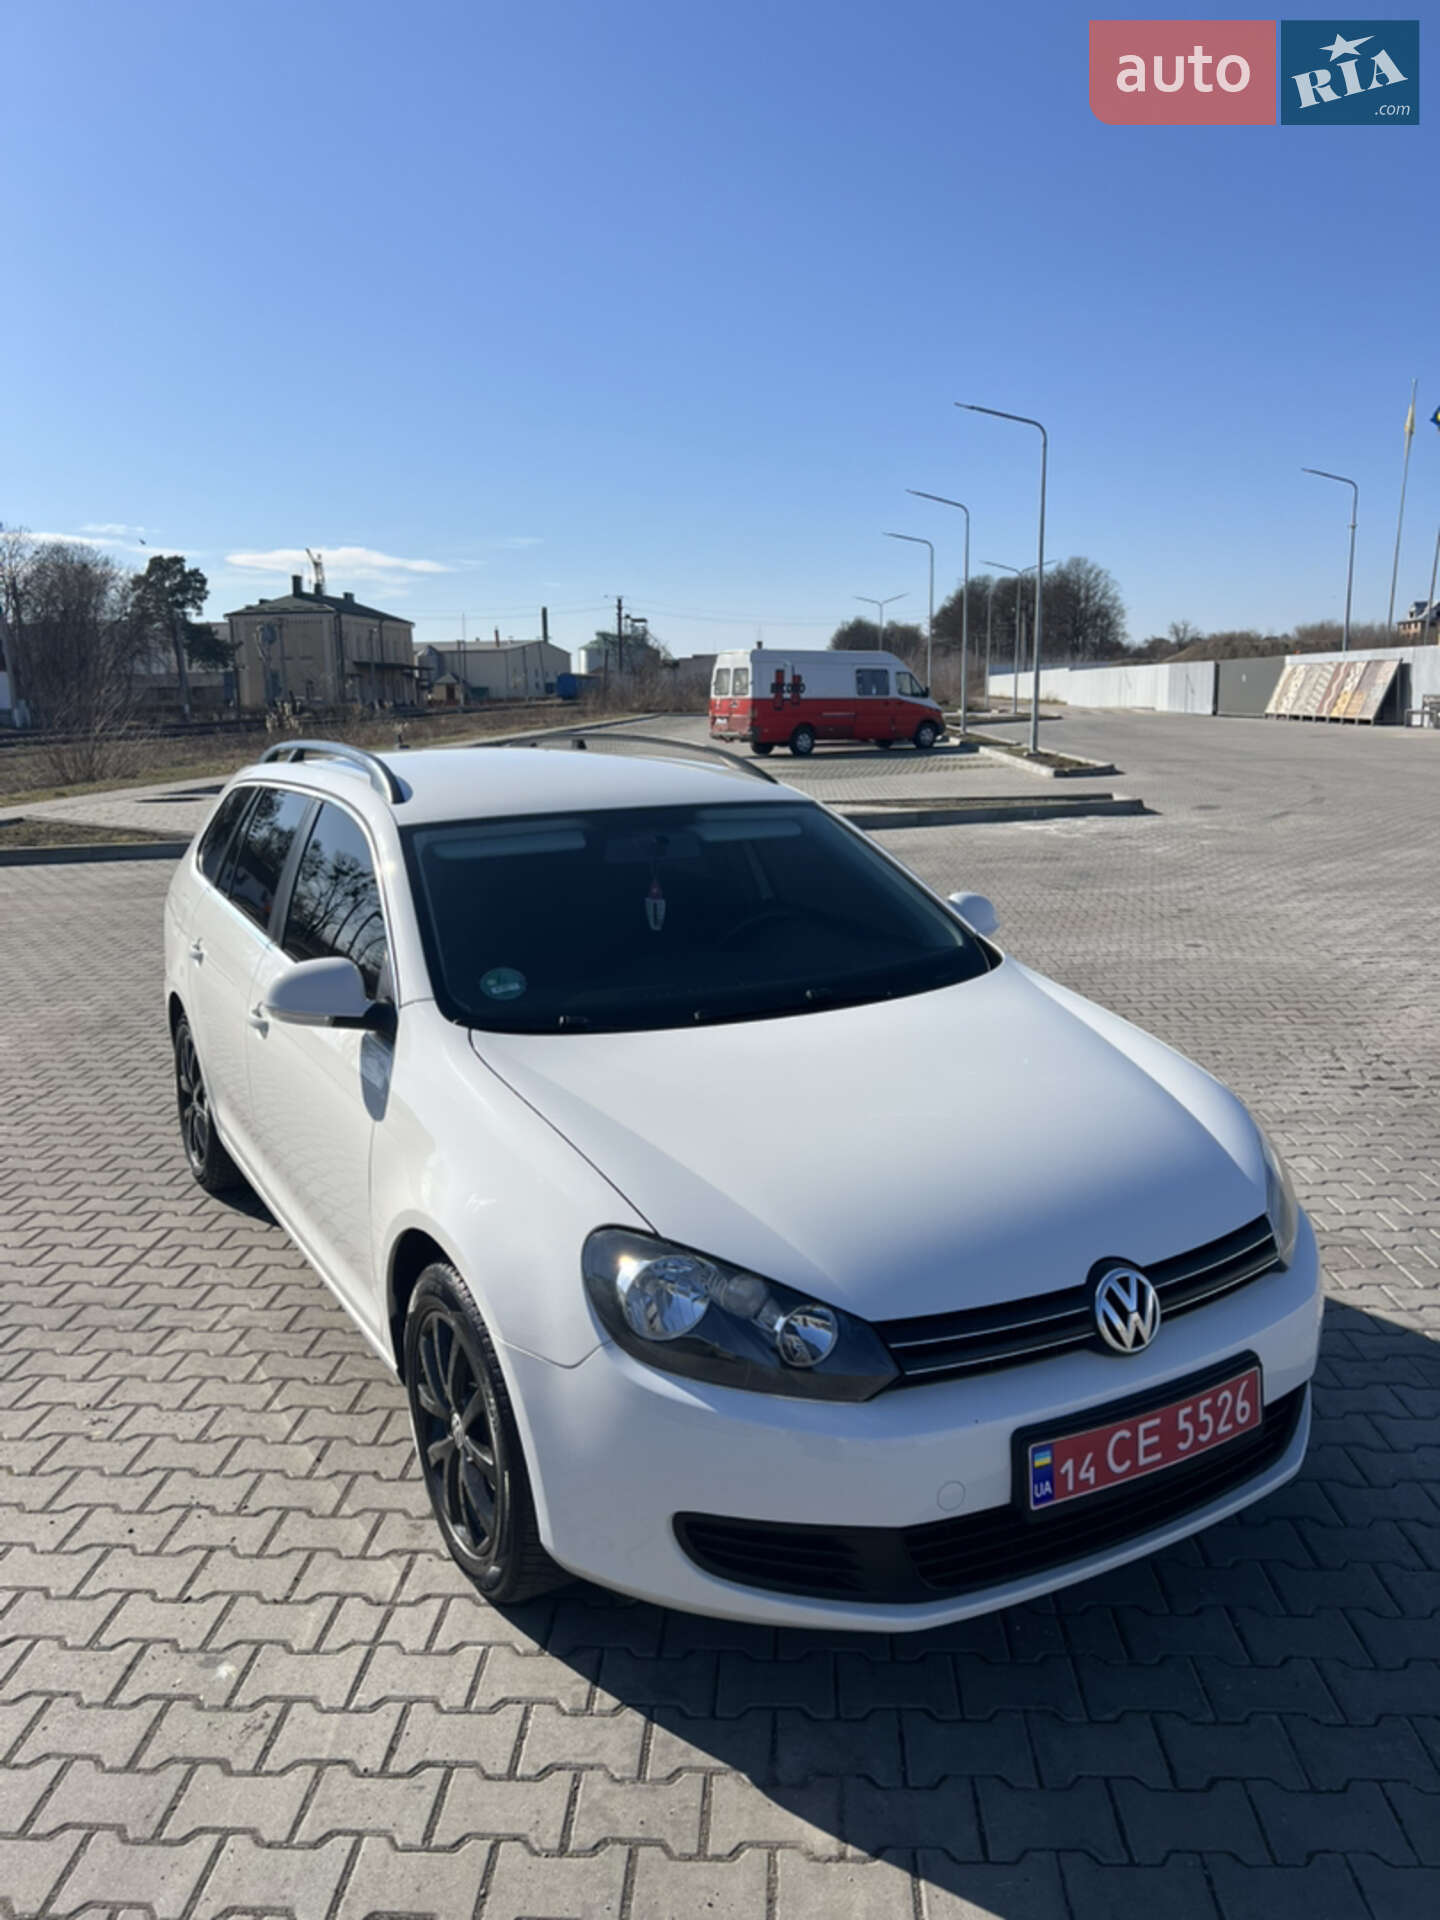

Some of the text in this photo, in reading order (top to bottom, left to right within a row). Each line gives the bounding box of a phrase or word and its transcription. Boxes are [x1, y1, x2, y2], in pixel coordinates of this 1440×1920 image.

[1097, 1269, 1160, 1351] VW
[1060, 1380, 1251, 1491] 14 CE 5526
[1034, 1480, 1052, 1498] UA
